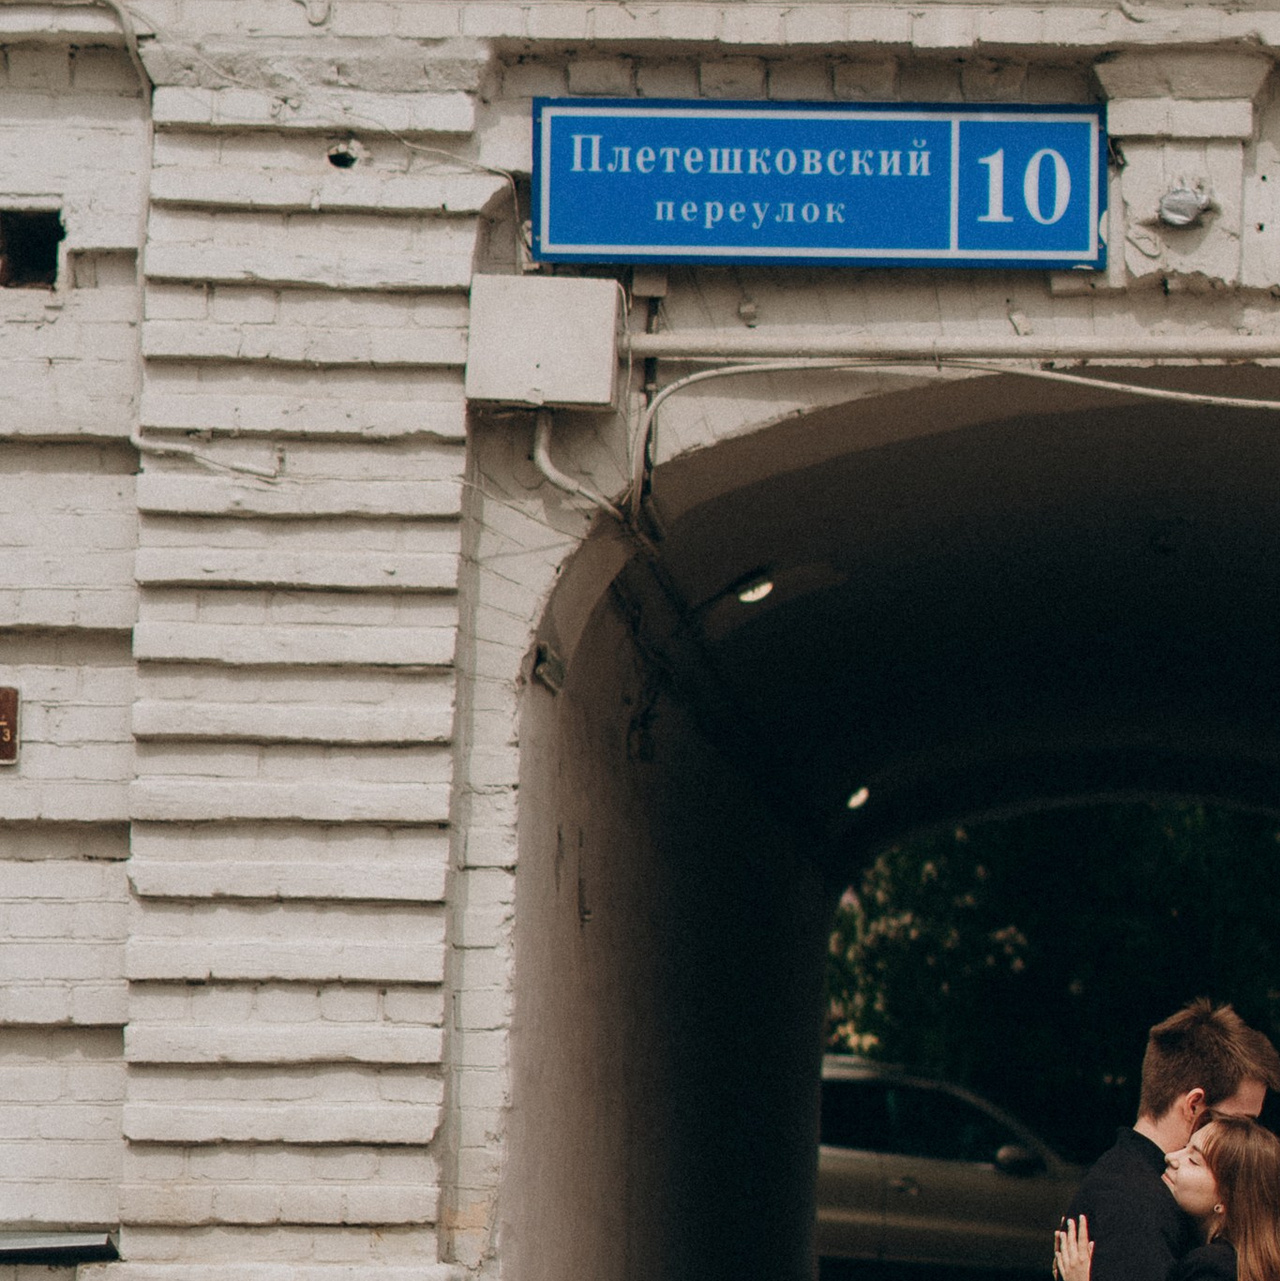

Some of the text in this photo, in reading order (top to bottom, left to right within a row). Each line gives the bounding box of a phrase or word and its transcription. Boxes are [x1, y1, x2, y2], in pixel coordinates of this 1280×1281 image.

[571, 134, 931, 176] Плетешковский
[976, 148, 1072, 225] 10
[655, 200, 846, 230] переулок
